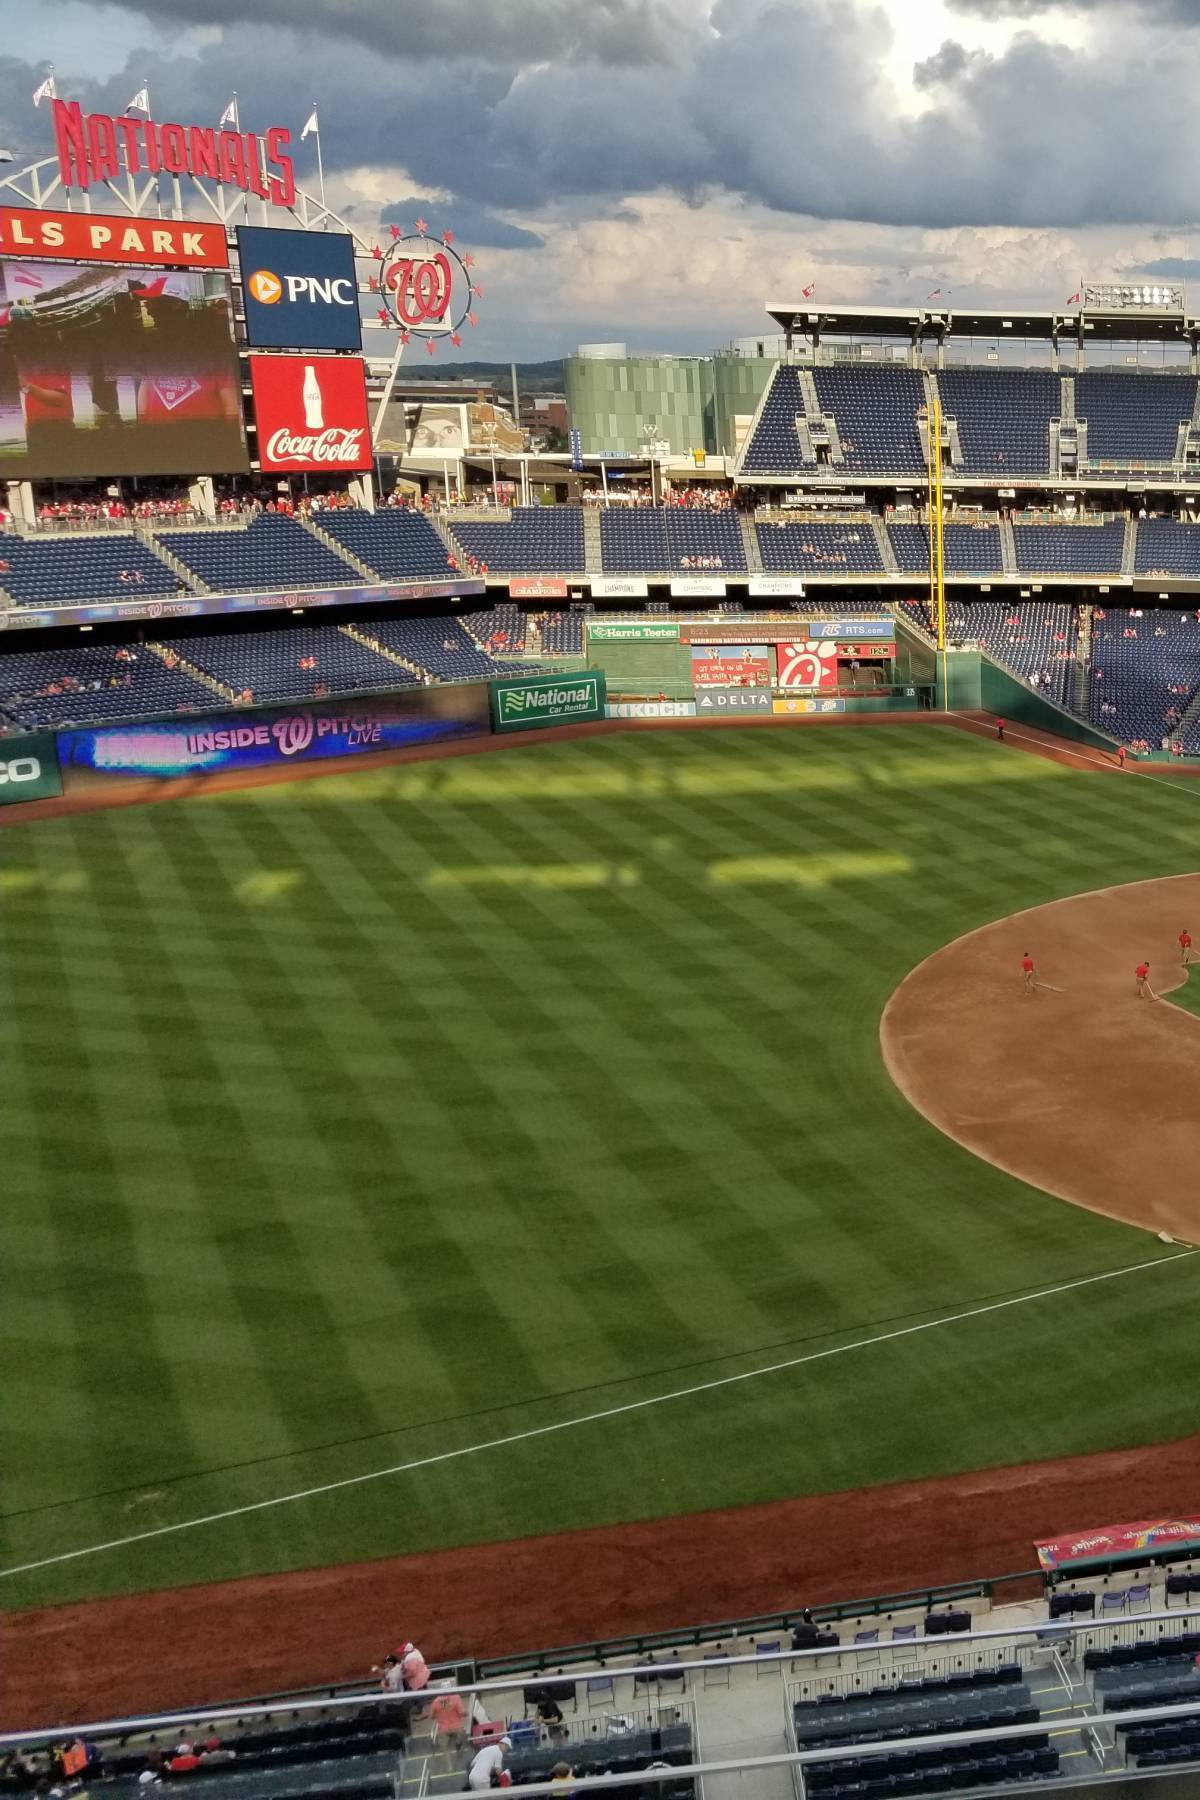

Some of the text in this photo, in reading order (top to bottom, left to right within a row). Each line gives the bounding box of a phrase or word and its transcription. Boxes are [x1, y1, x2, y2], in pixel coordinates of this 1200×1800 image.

[52, 98, 296, 207] NATIONALS
[0, 219, 206, 257] LS PARK
[284, 275, 354, 306] PNC
[266, 427, 365, 463] Coca-Cola
[257, 597, 284, 606] INSIDE
[118, 607, 147, 616] INSIDE
[607, 627, 677, 637] Harris Teeter
[845, 625, 884, 635] RTS.com
[718, 694, 769, 706] DELTA
[549, 702, 589, 714] Car Rental
[629, 702, 689, 717] KOCH
[187, 726, 270, 754] INSIDE
[317, 714, 383, 736] PITCH
[348, 728, 382, 745] LIVE
